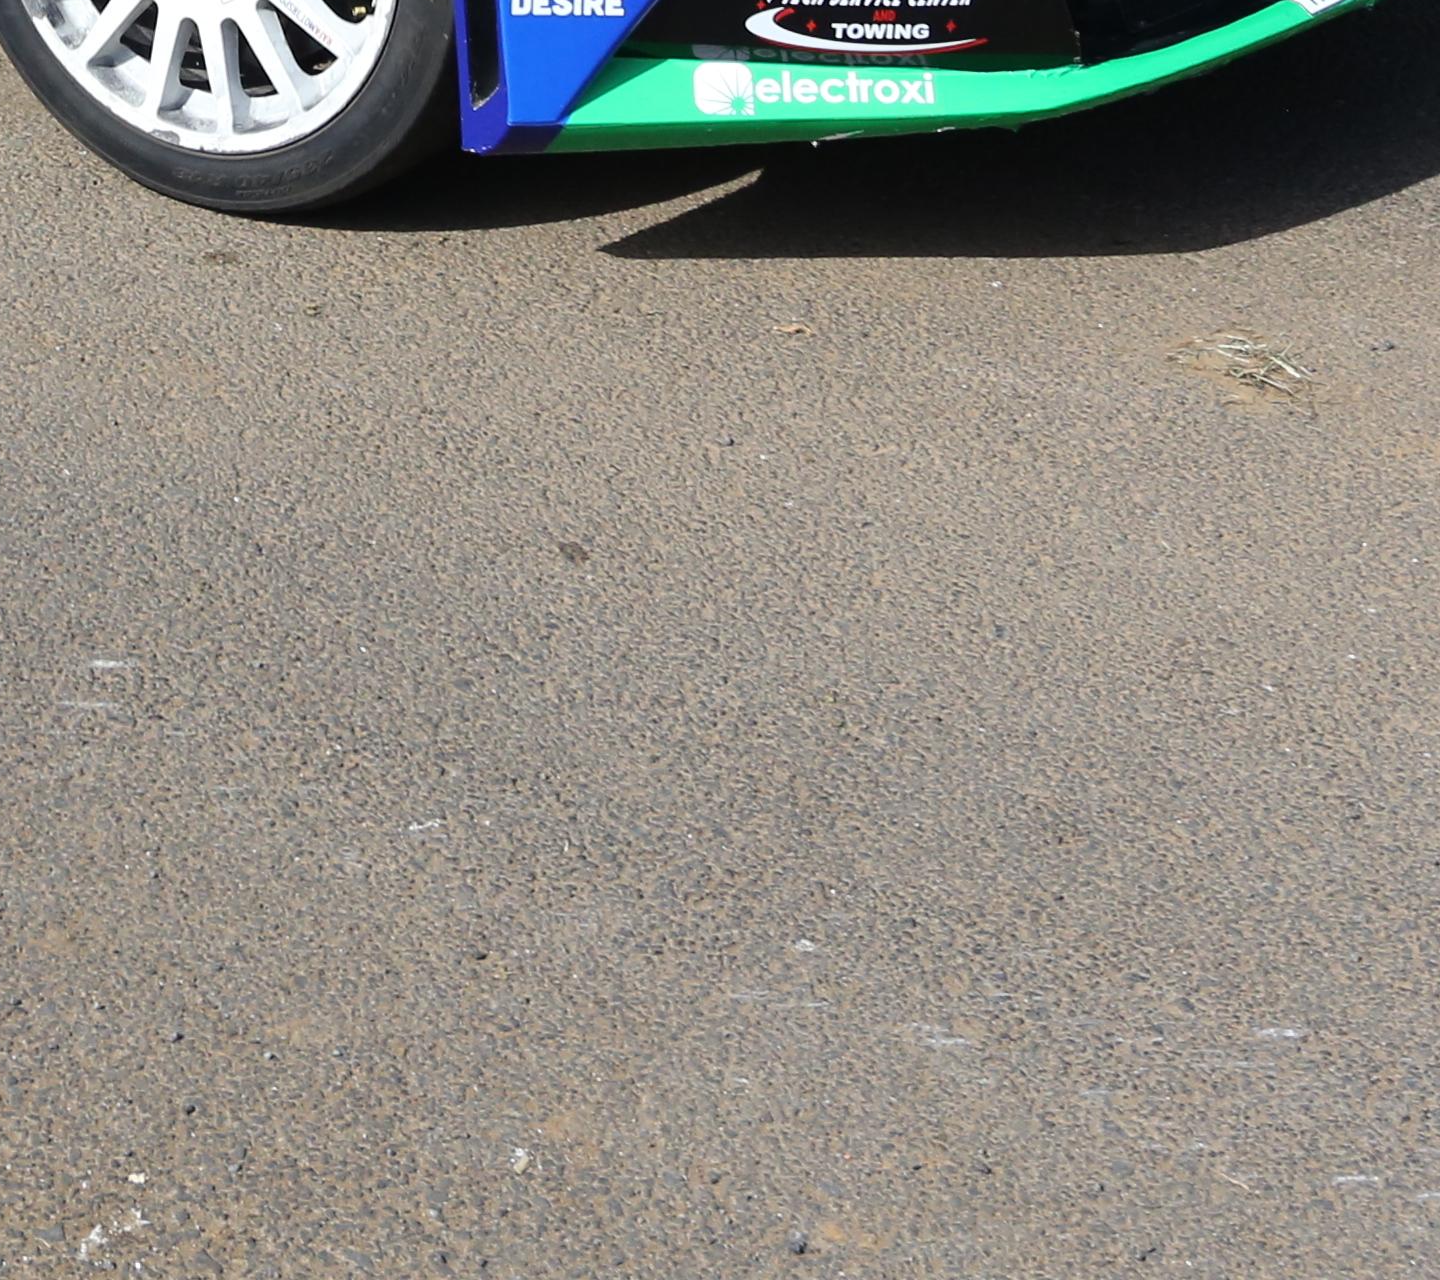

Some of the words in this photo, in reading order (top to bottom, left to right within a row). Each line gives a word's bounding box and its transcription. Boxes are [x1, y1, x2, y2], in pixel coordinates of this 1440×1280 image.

[872, 9, 897, 22] AND
[831, 22, 930, 40] TOWING
[754, 70, 935, 104] electroxi
